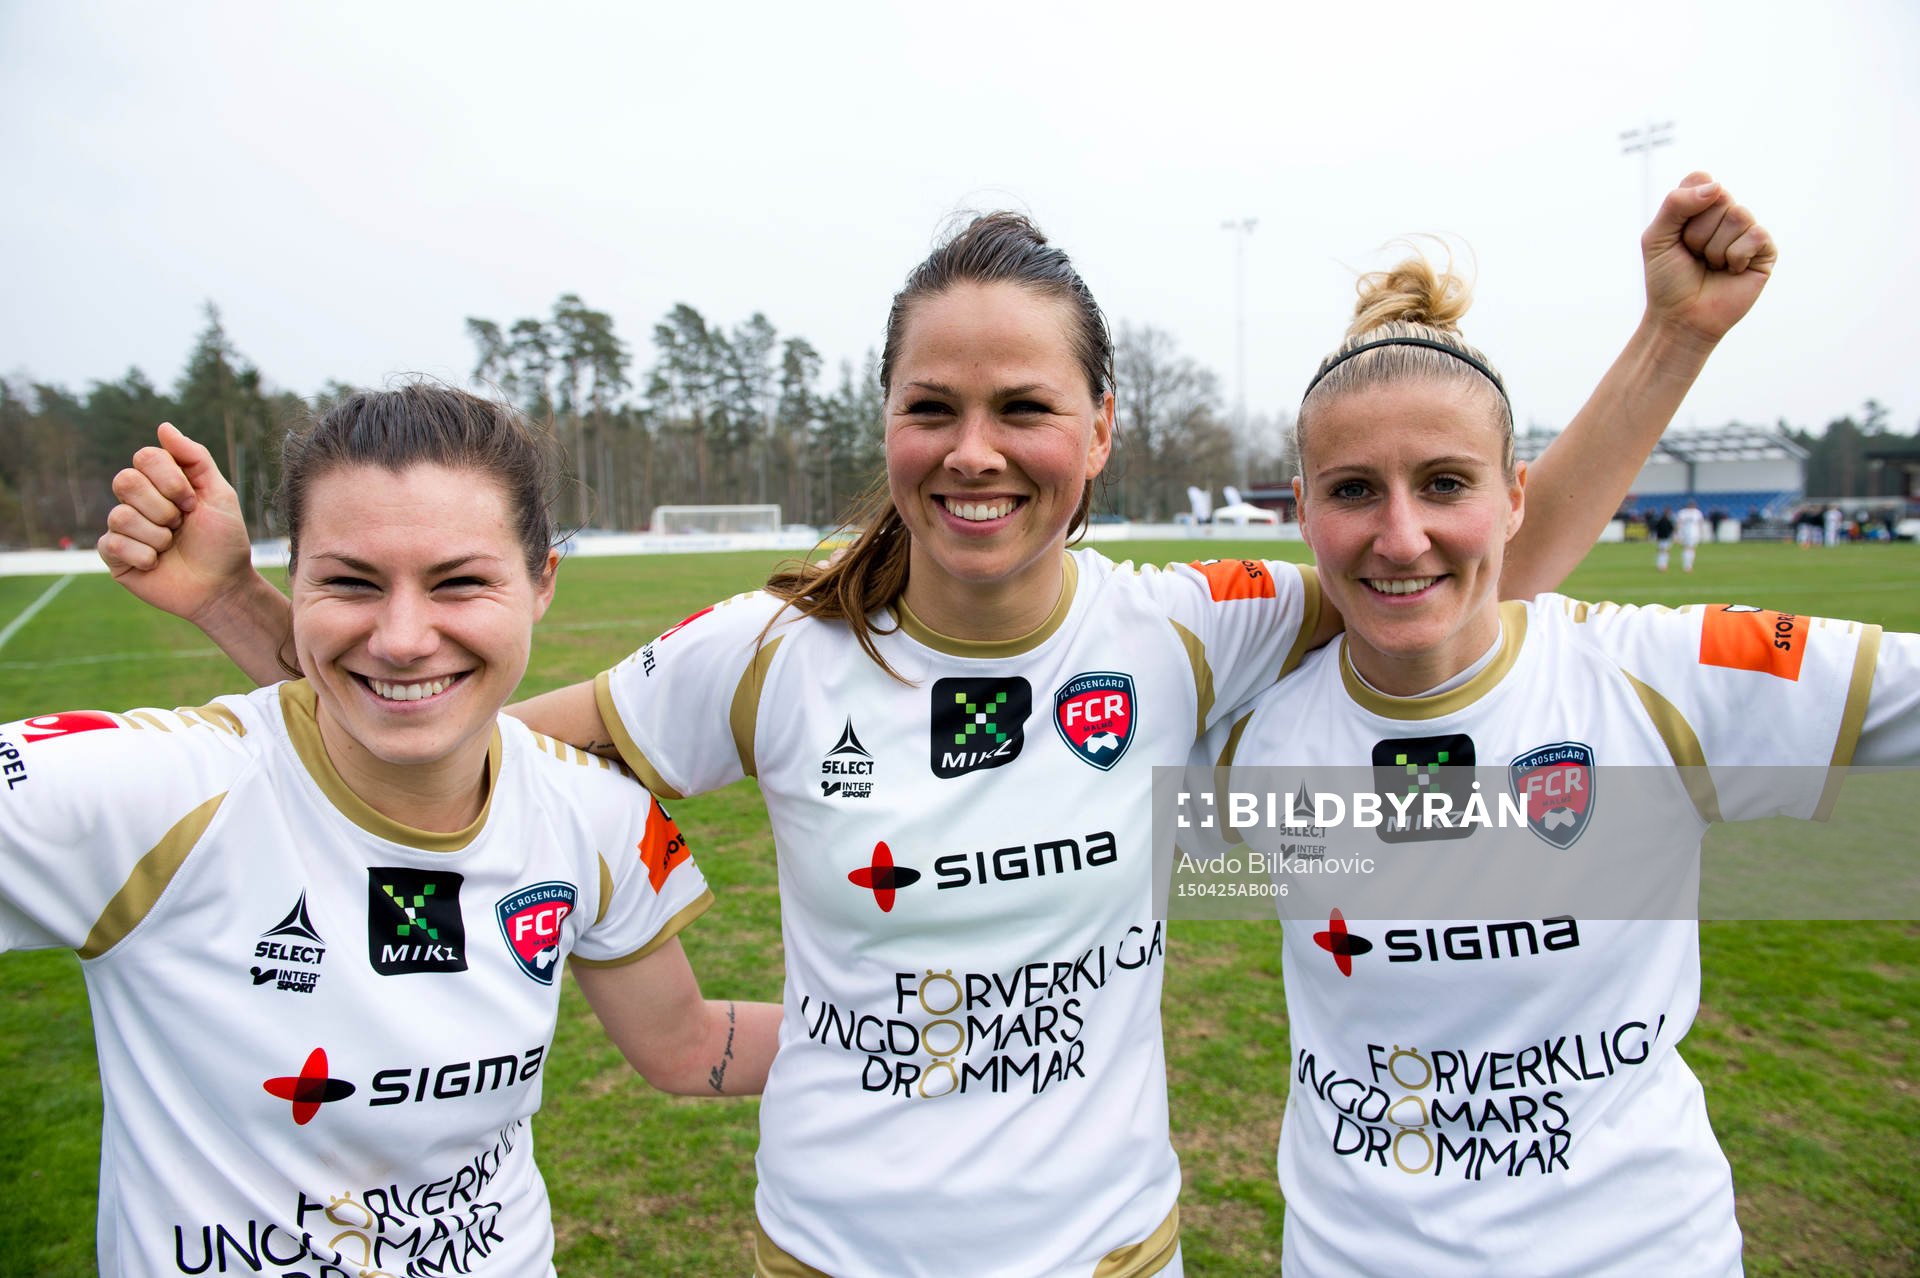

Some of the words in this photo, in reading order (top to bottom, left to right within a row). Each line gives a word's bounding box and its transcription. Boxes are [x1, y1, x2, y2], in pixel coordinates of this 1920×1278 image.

[1060, 689, 1069, 701] FC
[1069, 676, 1124, 694] ROSENGÅRD
[1066, 694, 1126, 727] FCR
[1083, 720, 1113, 733] MALMÖ
[941, 738, 1013, 769] MIKZ
[1516, 762, 1530, 774] FC
[1531, 748, 1585, 768] ROSENGÅRD
[821, 760, 875, 776] SELECT
[842, 781, 872, 791] INTER
[1526, 767, 1584, 801] FCR
[1297, 844, 1326, 855] INTER
[504, 902, 517, 914] FC
[517, 887, 573, 908] ROSENGÅRD
[254, 941, 326, 965] SELECT
[276, 980, 316, 994] SPORT
[278, 969, 319, 984] INTER
[1367, 1014, 1666, 1095] FÖRVERKLIG
[862, 1040, 1086, 1098] DRÖMMAR
[1333, 1113, 1572, 1180] DRÖMMAR
